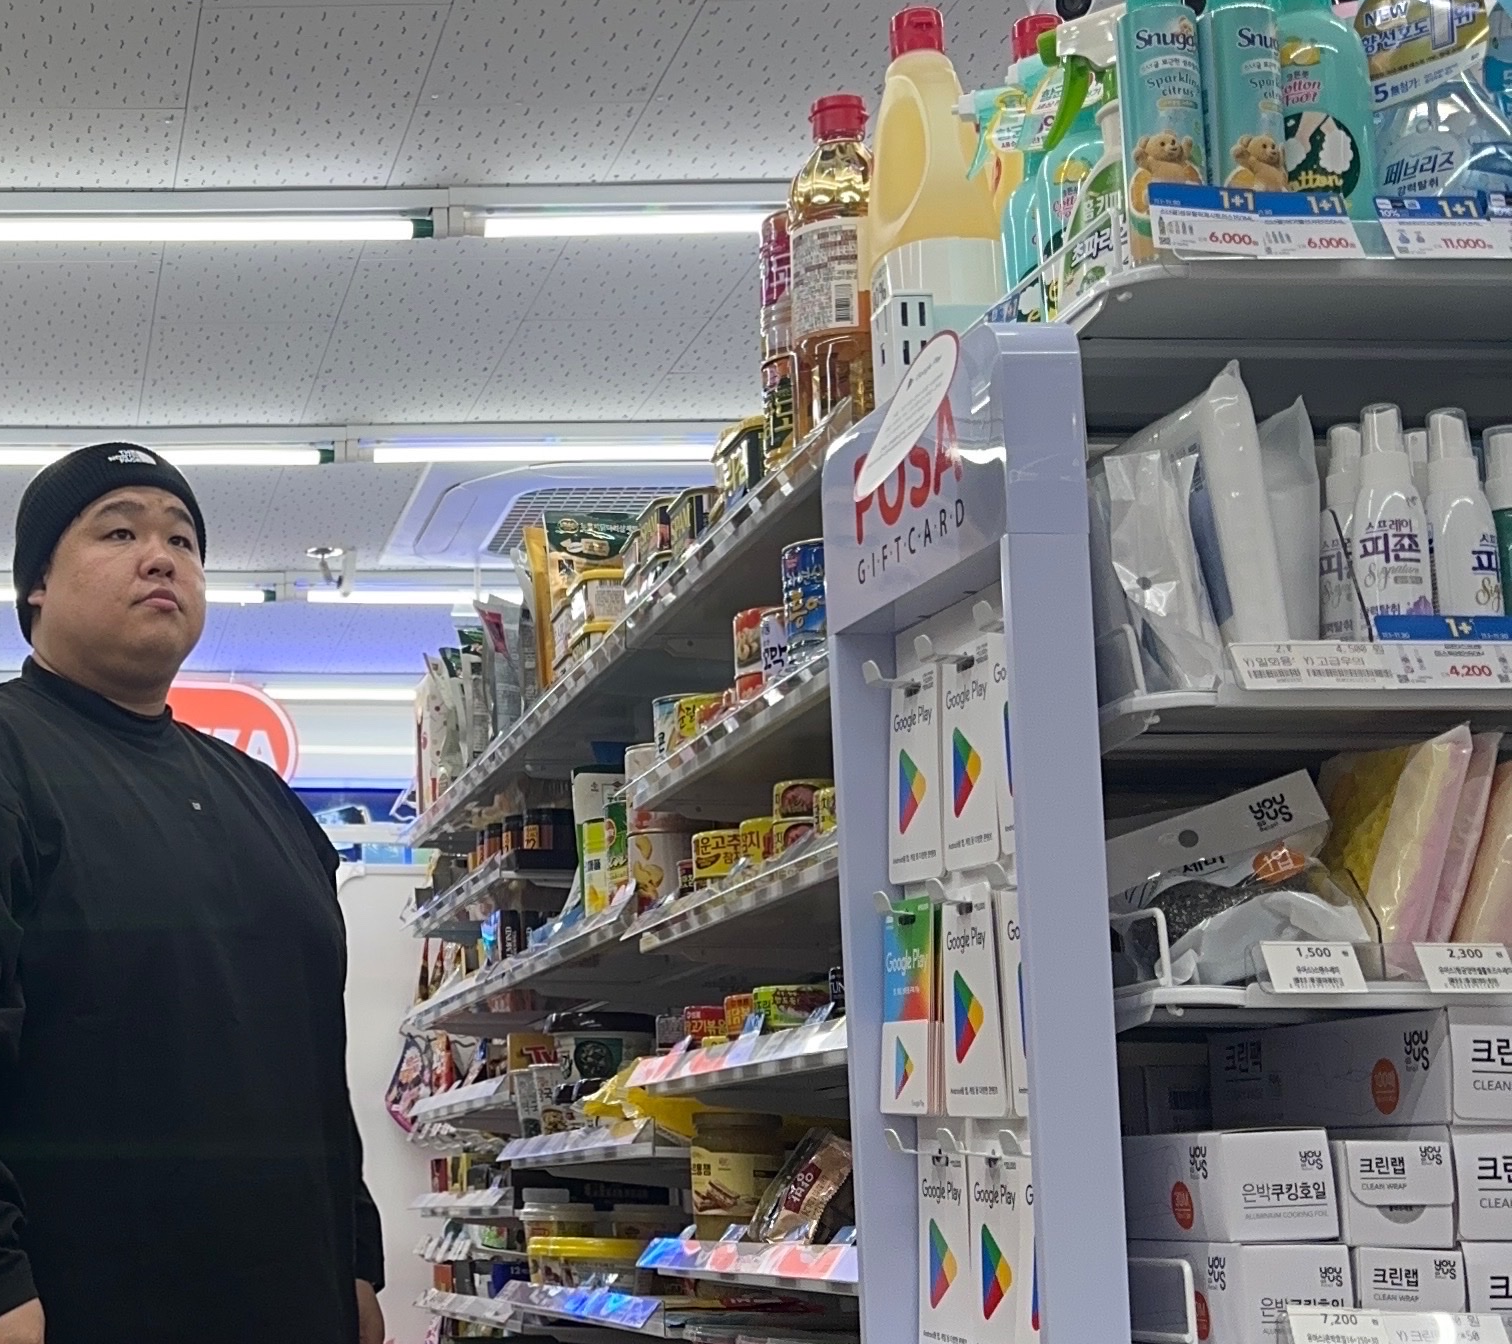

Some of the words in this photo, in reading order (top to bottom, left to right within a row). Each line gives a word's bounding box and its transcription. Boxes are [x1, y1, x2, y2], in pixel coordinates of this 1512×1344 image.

[1363, 1, 1409, 27] NEW
[1161, 83, 1196, 99] citrus
[1383, 151, 1455, 187] 페브리즈
[1219, 190, 1255, 212] 1+1
[1306, 195, 1345, 215] 1+1
[1437, 198, 1479, 219] 1+1
[1380, 208, 1401, 219] 10%
[1208, 231, 1253, 247] 6,000
[1307, 237, 1350, 250] 6,000
[1440, 237, 1487, 252] 11,000
[1365, 518, 1413, 533] 스프레이
[1359, 533, 1422, 564] 피죤
[1449, 665, 1493, 679] 4,200
[945, 686, 969, 711] Google
[970, 679, 986, 702] Play
[892, 710, 916, 734] Google
[917, 704, 932, 728] Play
[1249, 792, 1285, 821] you
[946, 931, 970, 954] Google
[971, 929, 986, 951] Play
[885, 951, 912, 974] Google
[913, 949, 928, 972] Play
[1295, 946, 1332, 959] 1,500
[1446, 947, 1484, 960] 2,300
[1403, 1029, 1429, 1056] you
[1189, 1146, 1207, 1166] you
[1299, 1150, 1322, 1166] you
[1359, 1155, 1406, 1176] 크린랩
[922, 1177, 946, 1205] Google
[946, 1182, 962, 1207] Play
[974, 1181, 999, 1208] Google
[1000, 1184, 1016, 1211] Play
[1241, 1180, 1327, 1204] 은박쿠킹호일
[1319, 1266, 1342, 1282] you
[1372, 1267, 1419, 1287] 크린랩
[1434, 1259, 1456, 1275] you
[1321, 1313, 1358, 1327] 7,200
